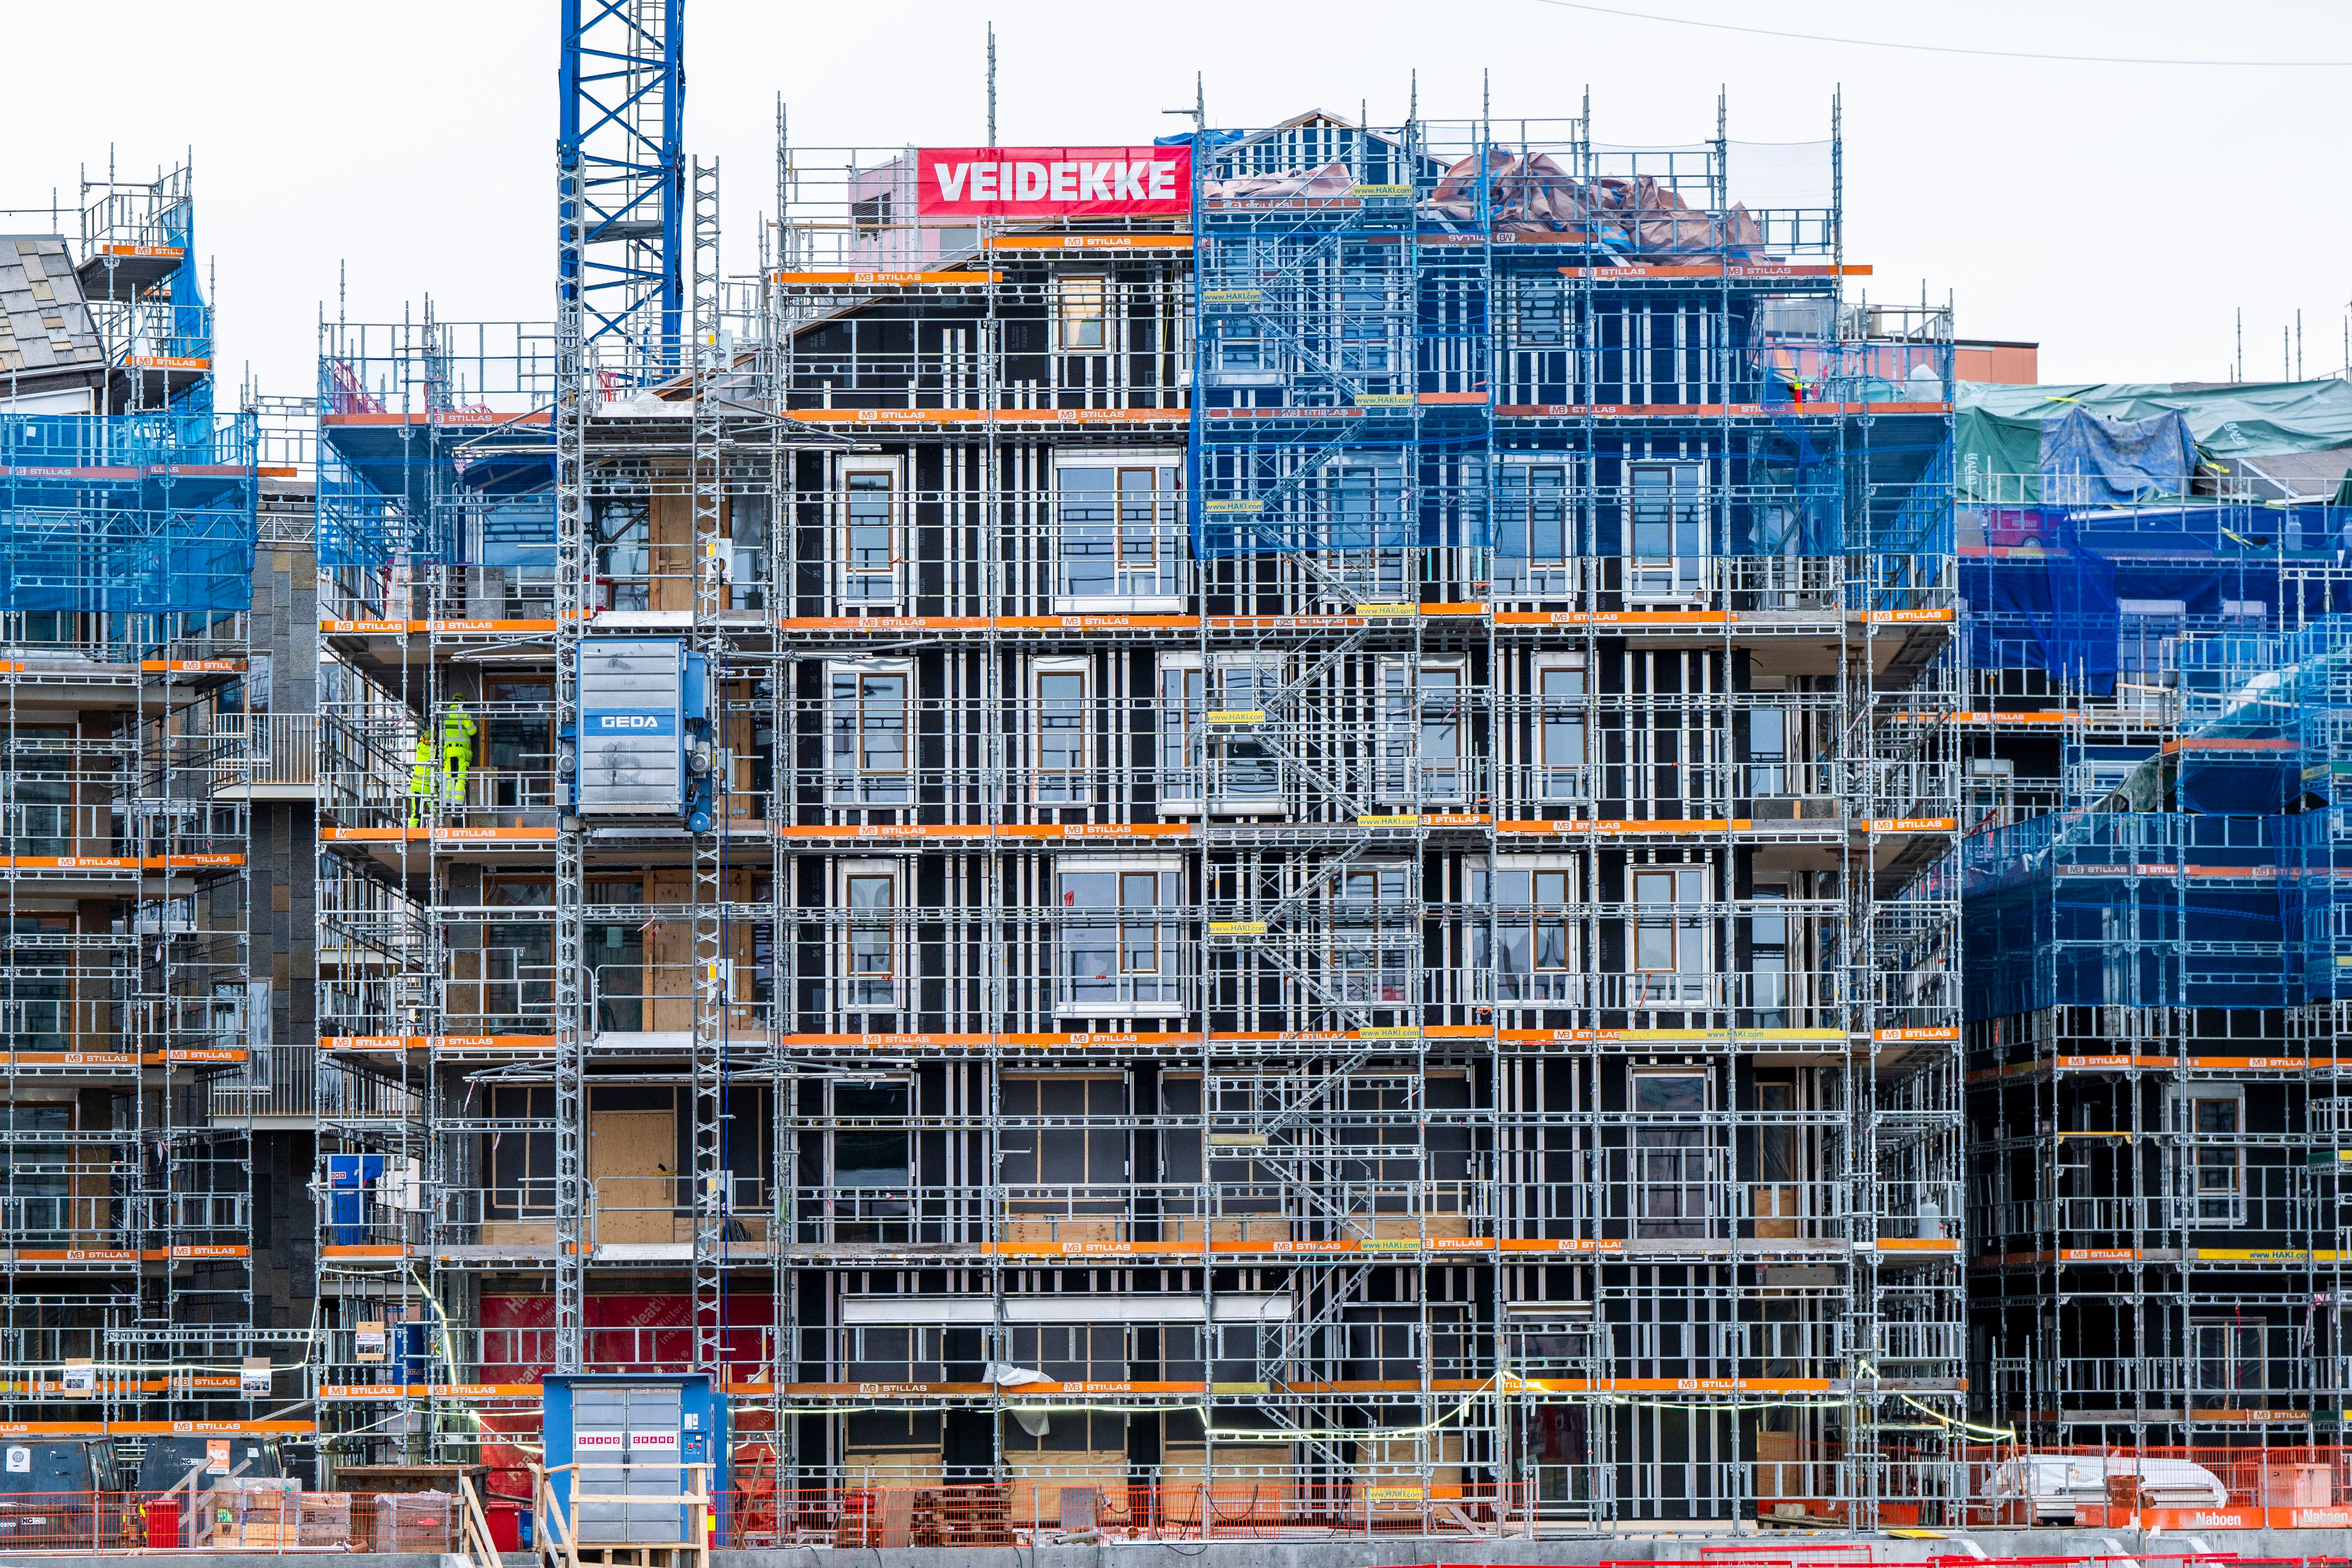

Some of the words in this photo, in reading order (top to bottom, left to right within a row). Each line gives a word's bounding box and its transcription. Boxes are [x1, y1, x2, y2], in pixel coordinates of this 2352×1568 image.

[934, 161, 1176, 201] VEIDEKKE
[602, 716, 658, 727] GEDA
[1438, 1239, 1483, 1247] STILLAS
[209, 1449, 228, 1460] NG
[2196, 1512, 2241, 1526] Naboen
[2304, 1509, 2348, 1523] Naboen
